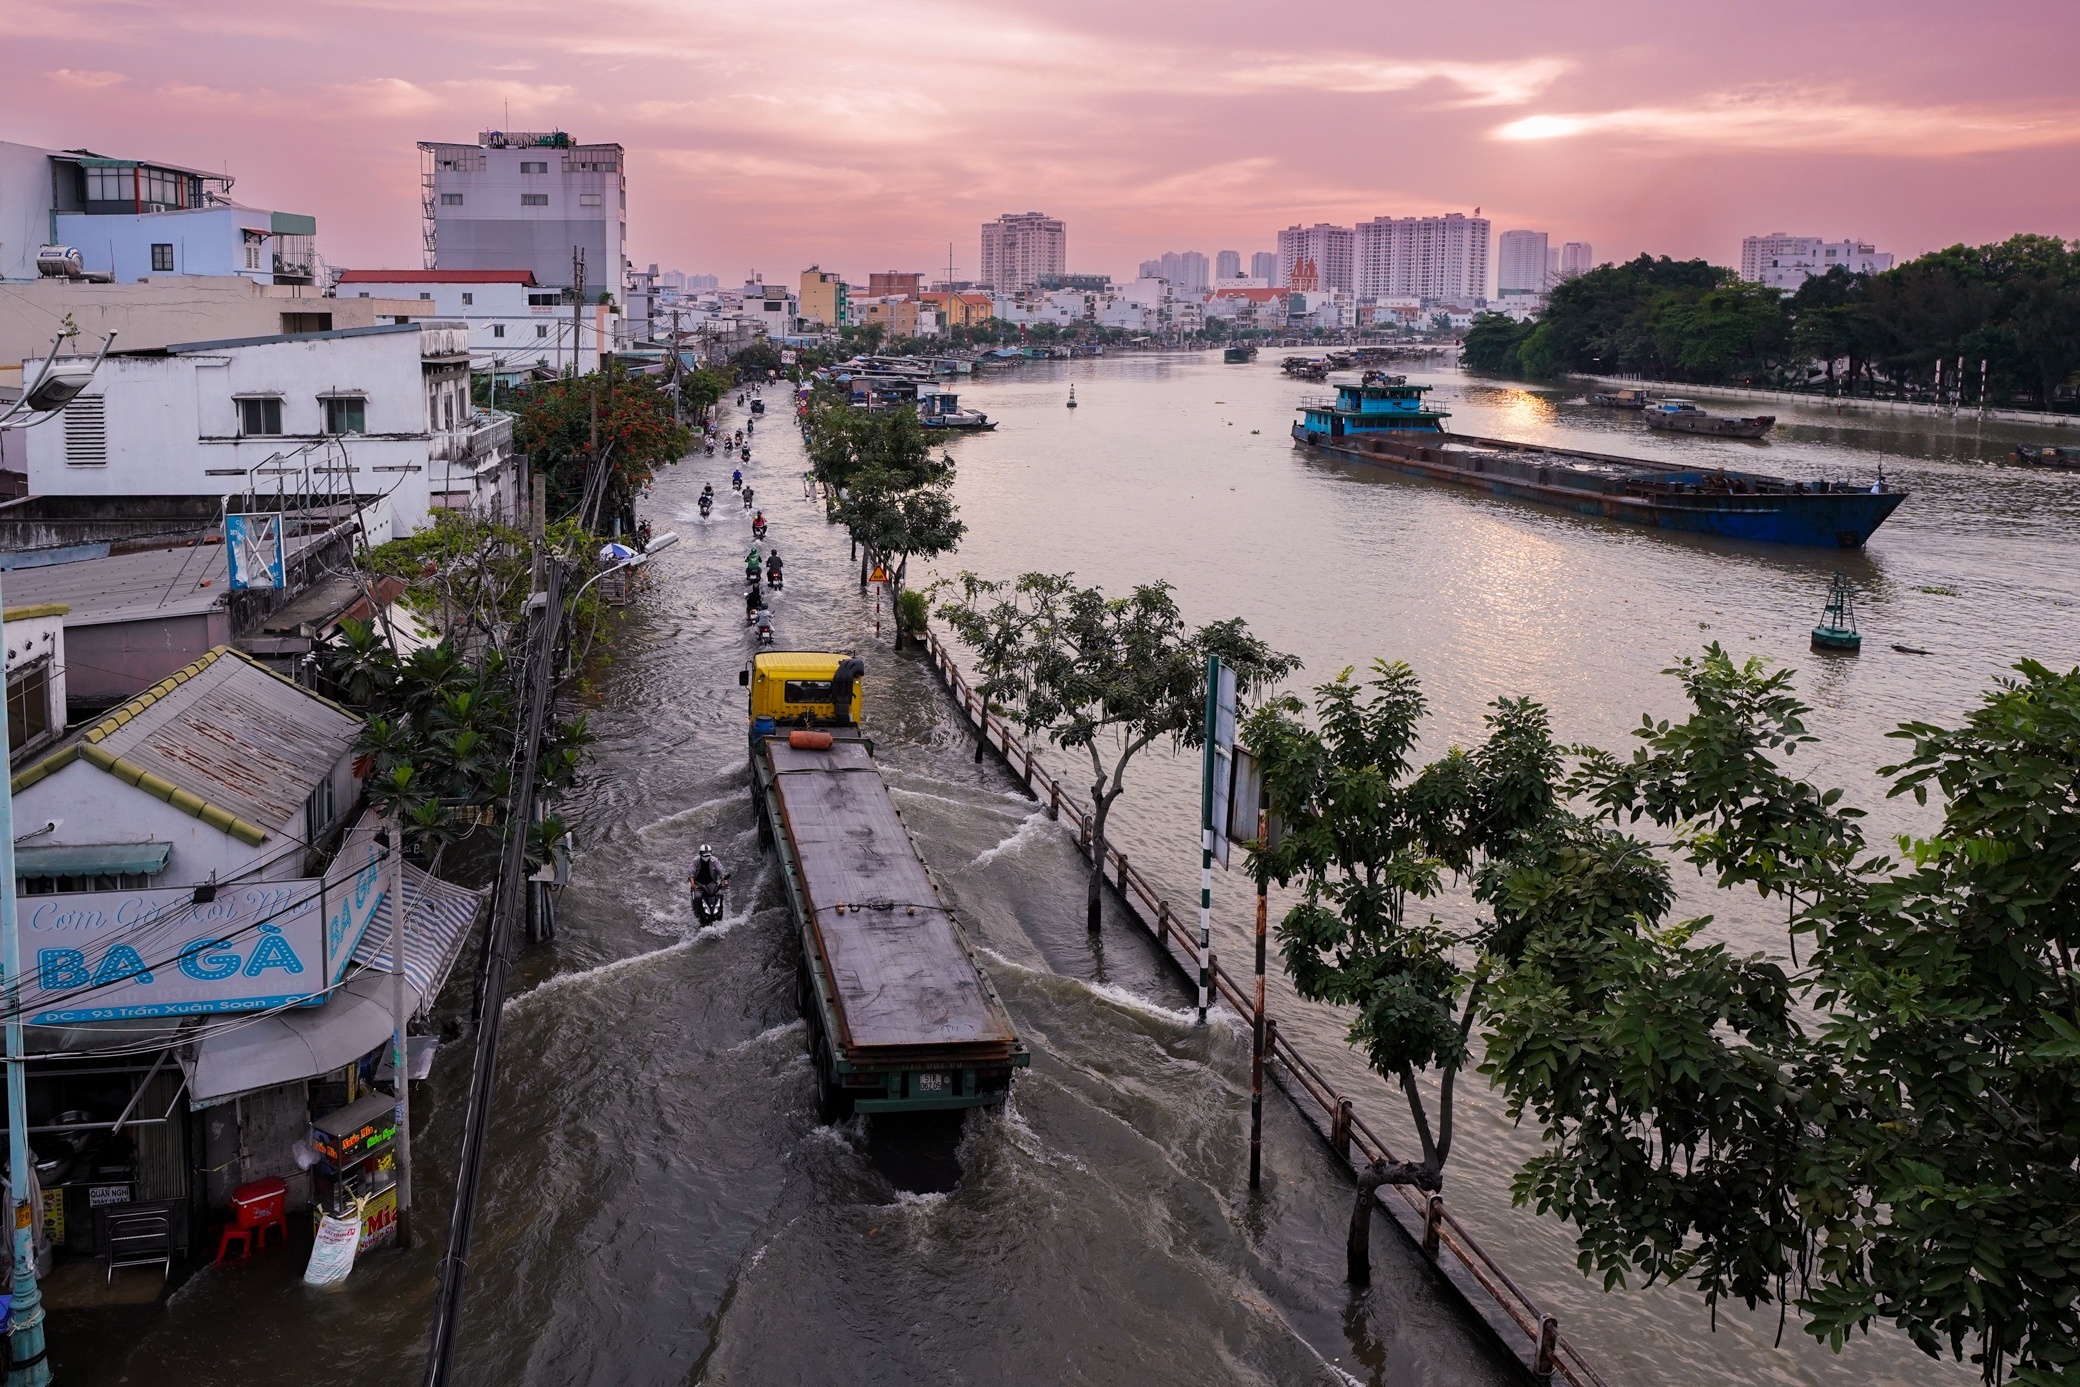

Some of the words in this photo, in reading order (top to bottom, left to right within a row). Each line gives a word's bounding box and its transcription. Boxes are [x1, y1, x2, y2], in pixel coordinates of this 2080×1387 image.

[37, 944, 154, 990] BA
[177, 923, 305, 981] GÀ
[91, 1010, 114, 1019] 93
[119, 1003, 159, 1017] Trần
[165, 1000, 214, 1014] Xuân
[219, 997, 266, 1011] Soạn
